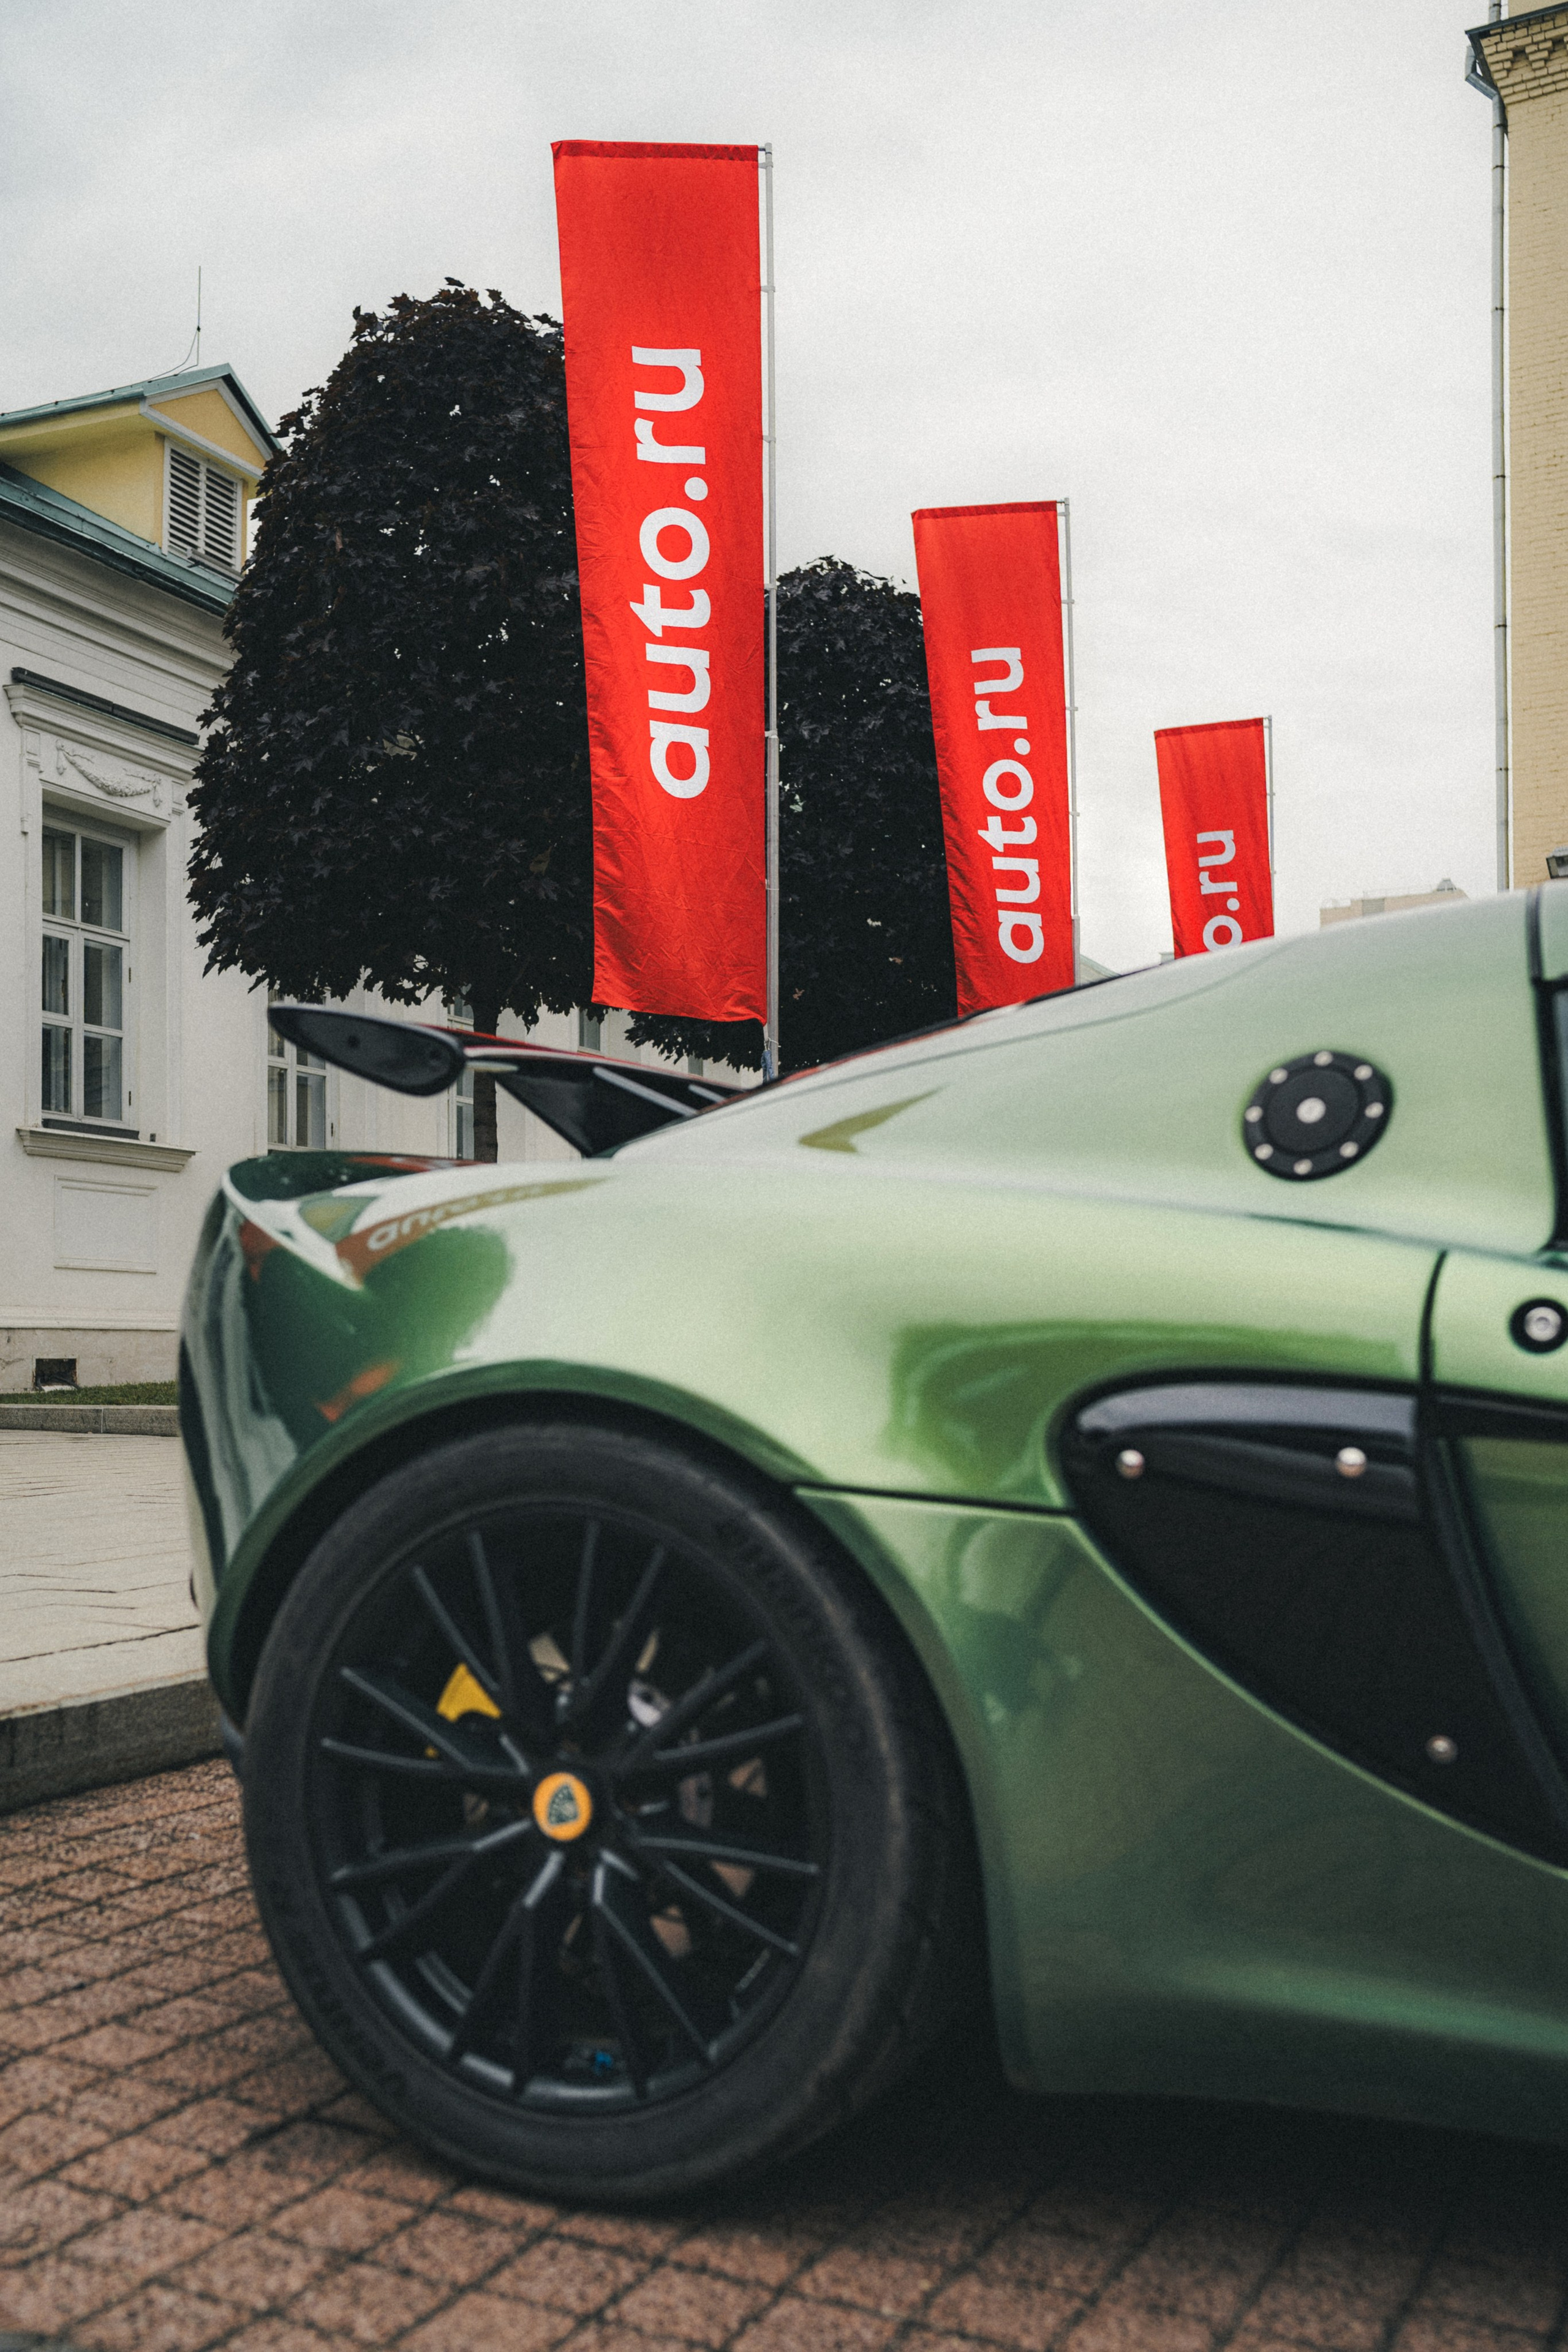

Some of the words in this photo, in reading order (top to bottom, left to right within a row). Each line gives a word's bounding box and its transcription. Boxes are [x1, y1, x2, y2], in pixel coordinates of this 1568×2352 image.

[629, 345, 712, 799] auto.ru
[971, 647, 1044, 963] auto.ru
[1197, 830, 1243, 952] o.ru
